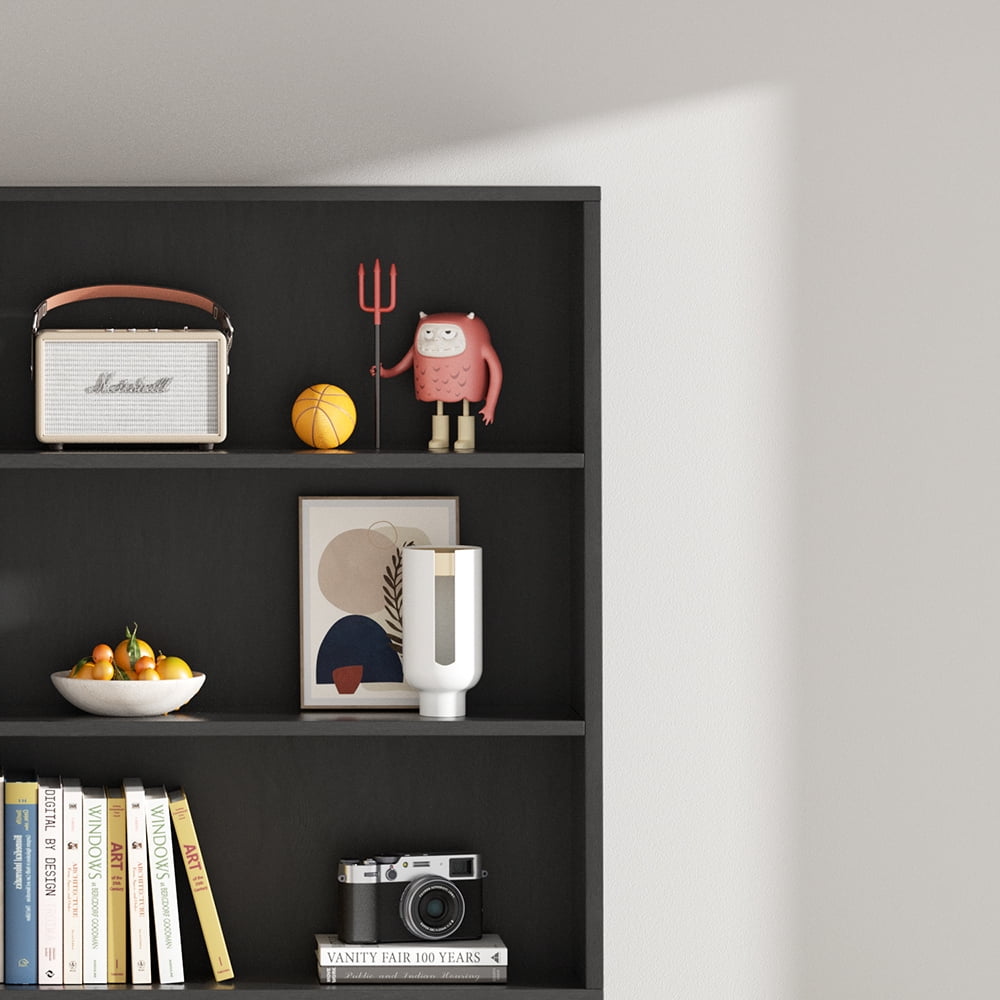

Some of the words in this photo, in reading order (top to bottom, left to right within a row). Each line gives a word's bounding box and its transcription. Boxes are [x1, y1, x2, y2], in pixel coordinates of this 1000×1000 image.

[45, 789, 56, 831] DIGITAL
[45, 839, 56, 850] BY
[88, 804, 102, 879] WINDOWS
[111, 842, 123, 871] ART
[183, 844, 201, 871] ART
[45, 858, 56, 896] DESIGN
[91, 888, 99, 917] BERGDORF
[327, 952, 378, 963] VANITY
[382, 952, 410, 963] FAIR
[416, 952, 435, 963] 100
[439, 952, 481, 963] YEARS
